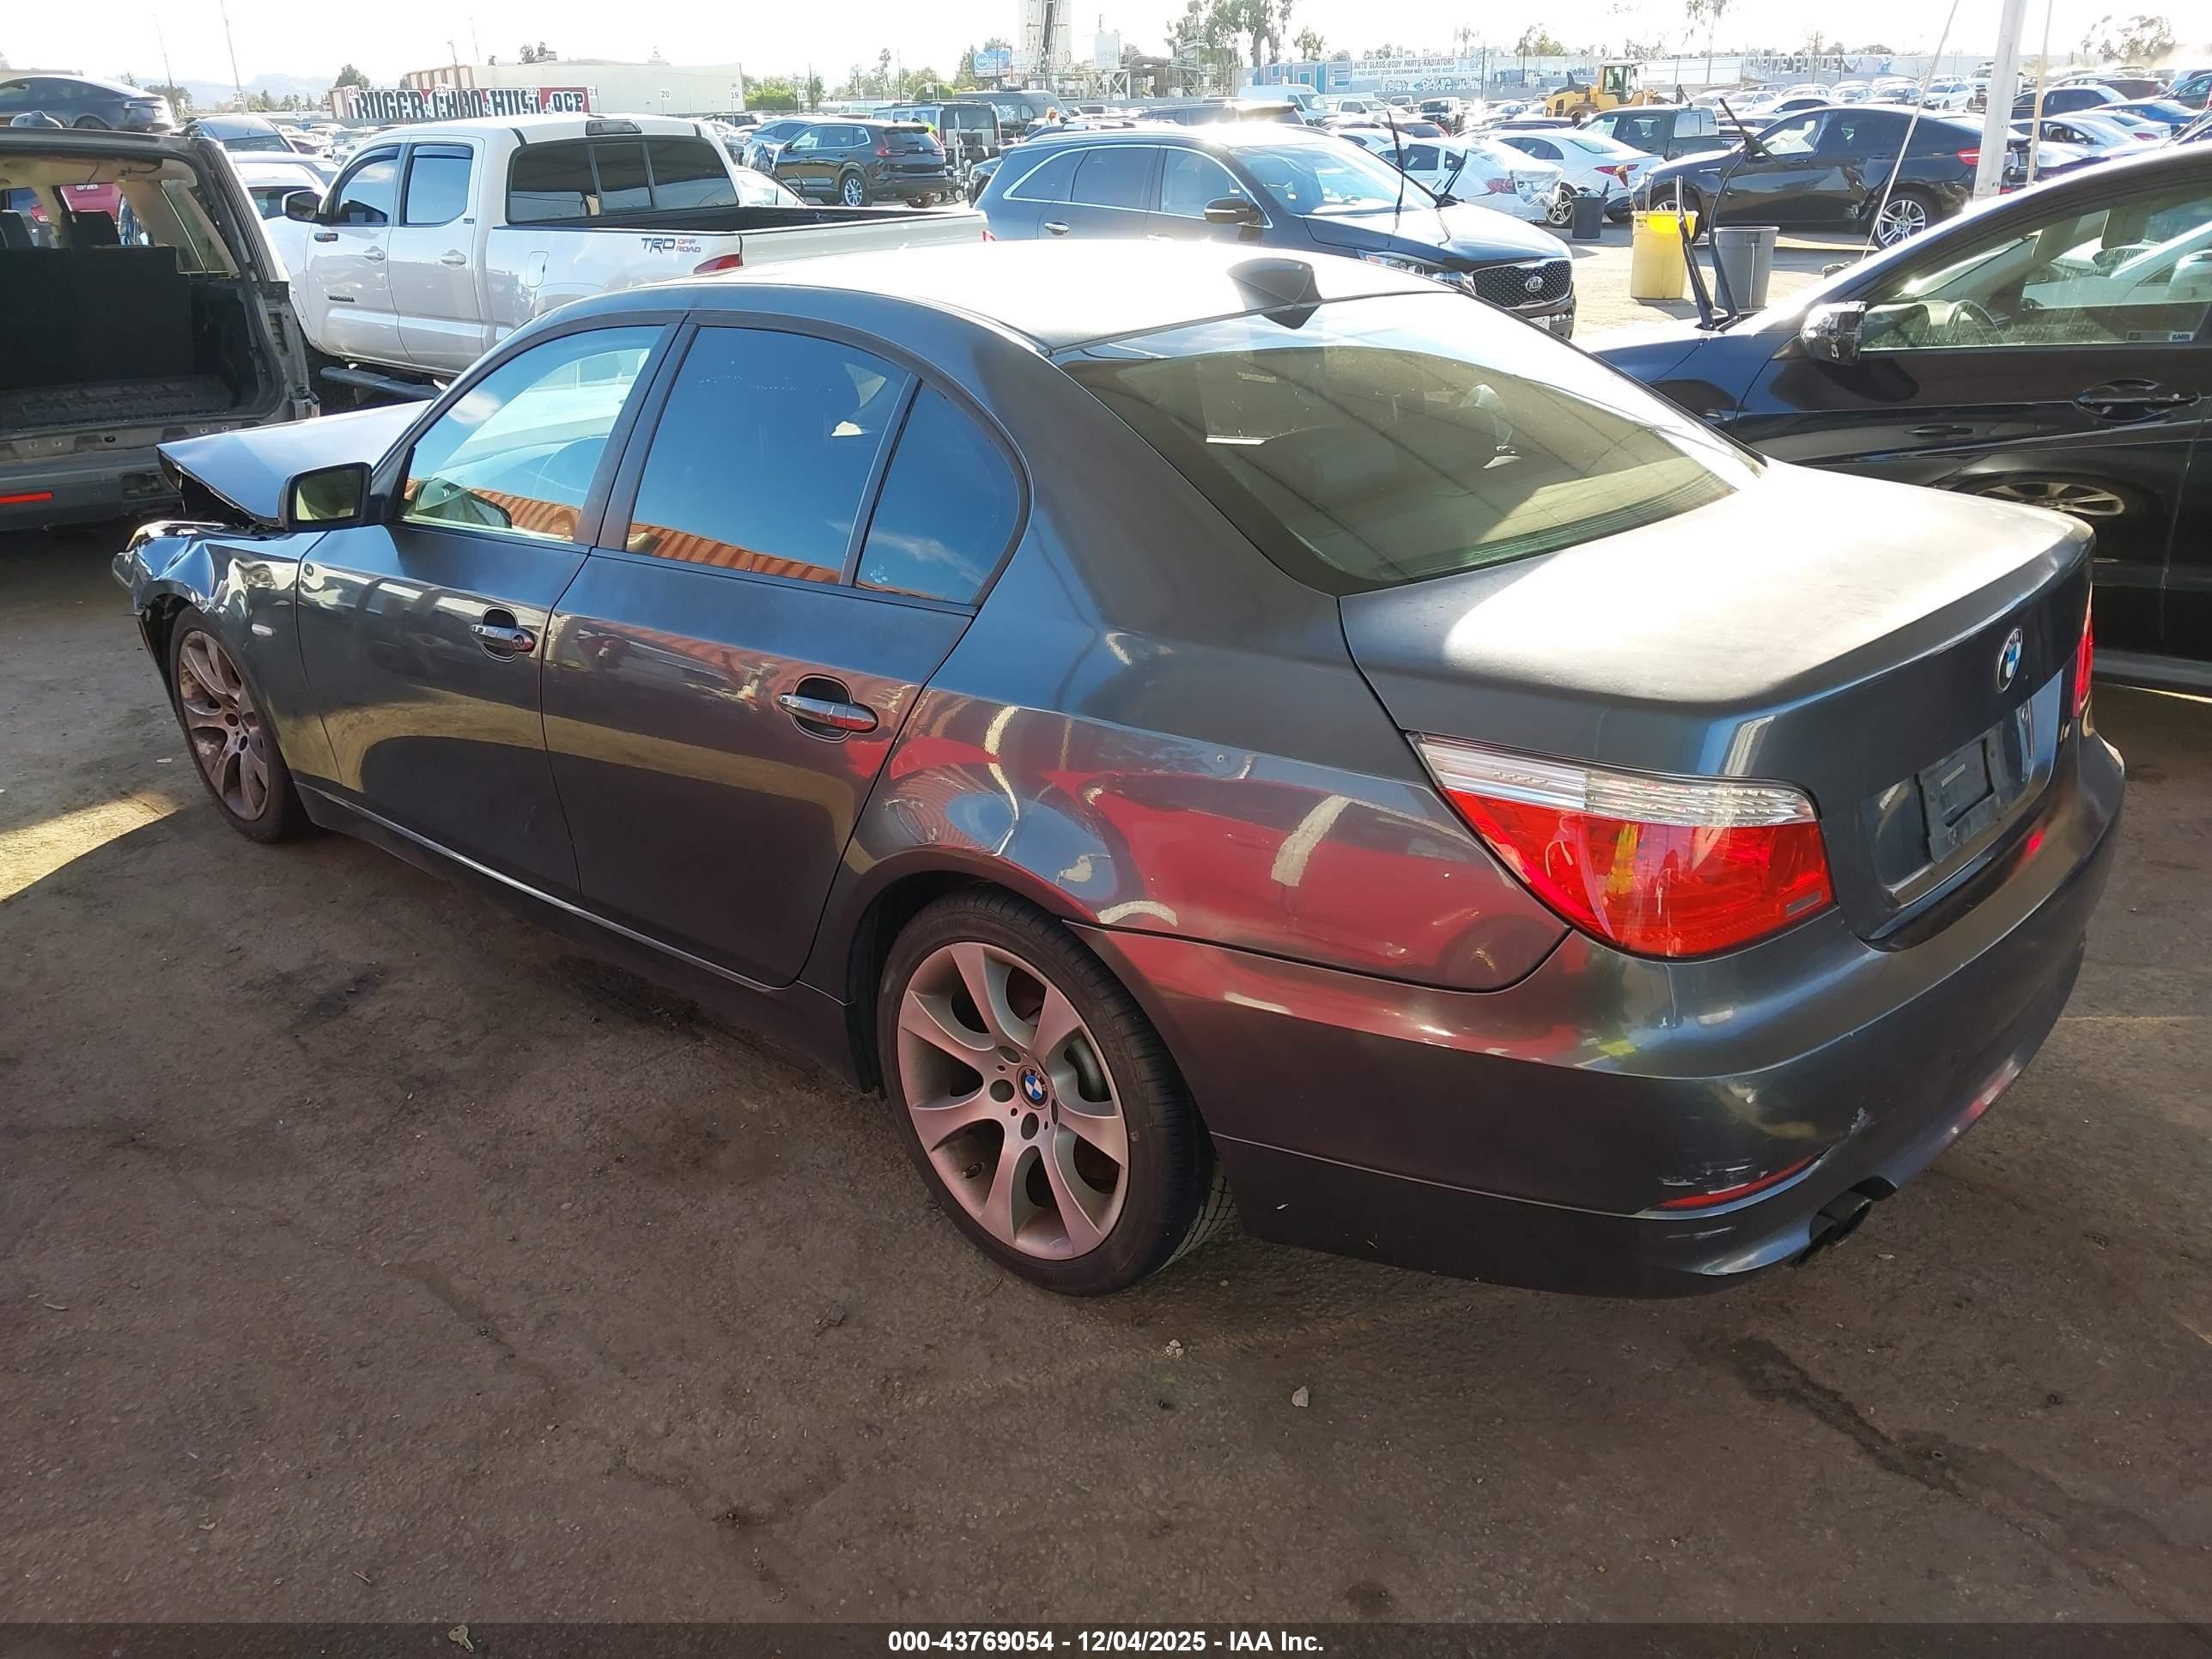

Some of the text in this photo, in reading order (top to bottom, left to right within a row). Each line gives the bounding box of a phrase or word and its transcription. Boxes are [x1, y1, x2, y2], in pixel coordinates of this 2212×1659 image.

[1370, 60, 1386, 69] GLASS
[1404, 58, 1422, 68] PARTS
[1423, 57, 1455, 66] RADIATORS
[348, 88, 358, 96] 24
[526, 87, 536, 95] 22
[730, 91, 738, 100] 19
[233, 93, 244, 102] 25
[641, 237, 676, 254] TRD
[1025, 1068, 1048, 1091] BMW
